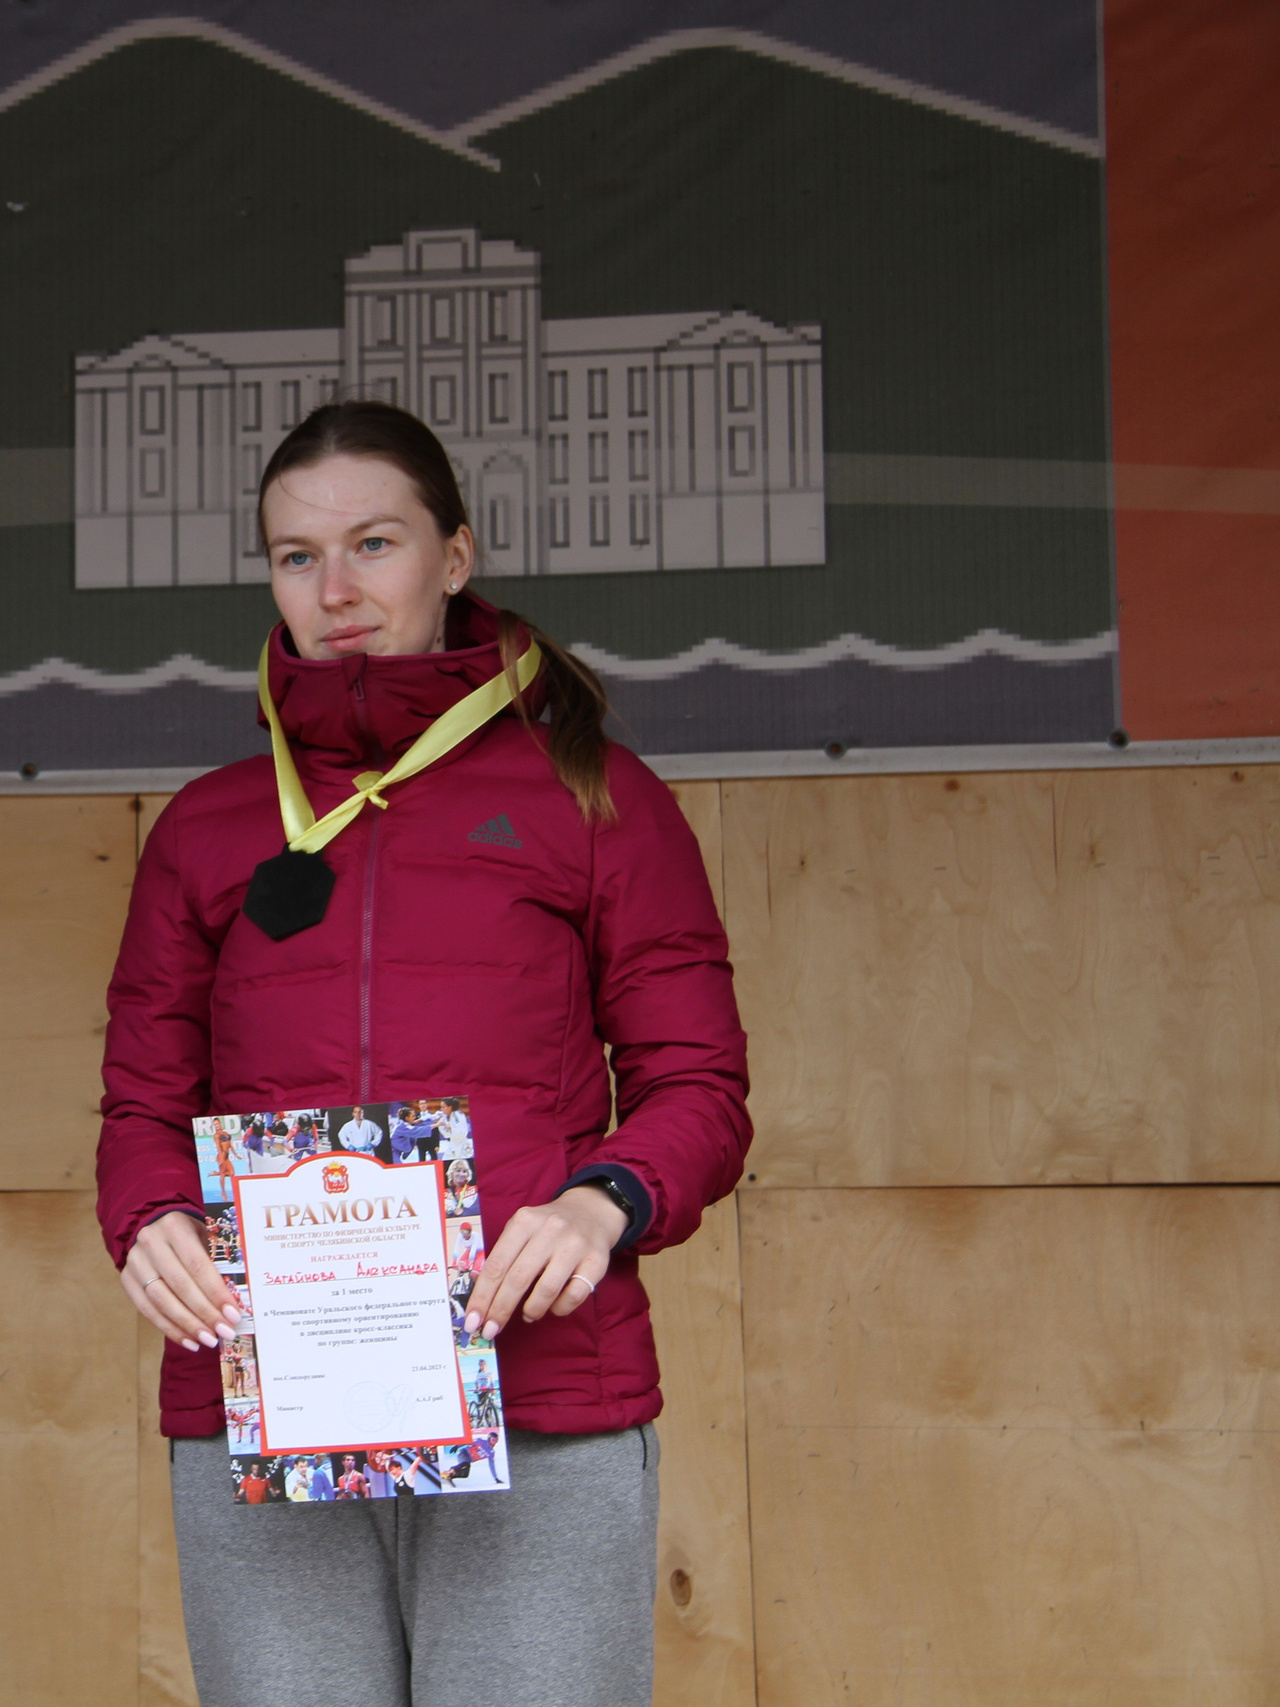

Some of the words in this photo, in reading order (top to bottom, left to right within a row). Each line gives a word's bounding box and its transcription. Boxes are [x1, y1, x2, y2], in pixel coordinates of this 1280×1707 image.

[467, 831, 524, 850] adidas
[262, 1195, 418, 1229] ГРАМОТА
[264, 1230, 322, 1241] МИНИСТЕРСТВО
[323, 1230, 334, 1238] ПО
[335, 1226, 384, 1237] ФИЗИЧЕСКОЙ
[385, 1223, 421, 1233] КУЛЬТУРЕ
[287, 1240, 316, 1249] СПОРТУ
[317, 1235, 371, 1247] ЧЕЛЯБИНСКОЙ
[372, 1233, 406, 1243] ОБЛАСТИ
[311, 1251, 379, 1263] НАГРАЖДАЕТСЯ
[270, 1308, 316, 1318] Чемпионате
[317, 1305, 363, 1316] Уральского
[364, 1300, 417, 1312] федерального
[419, 1298, 446, 1307] округа
